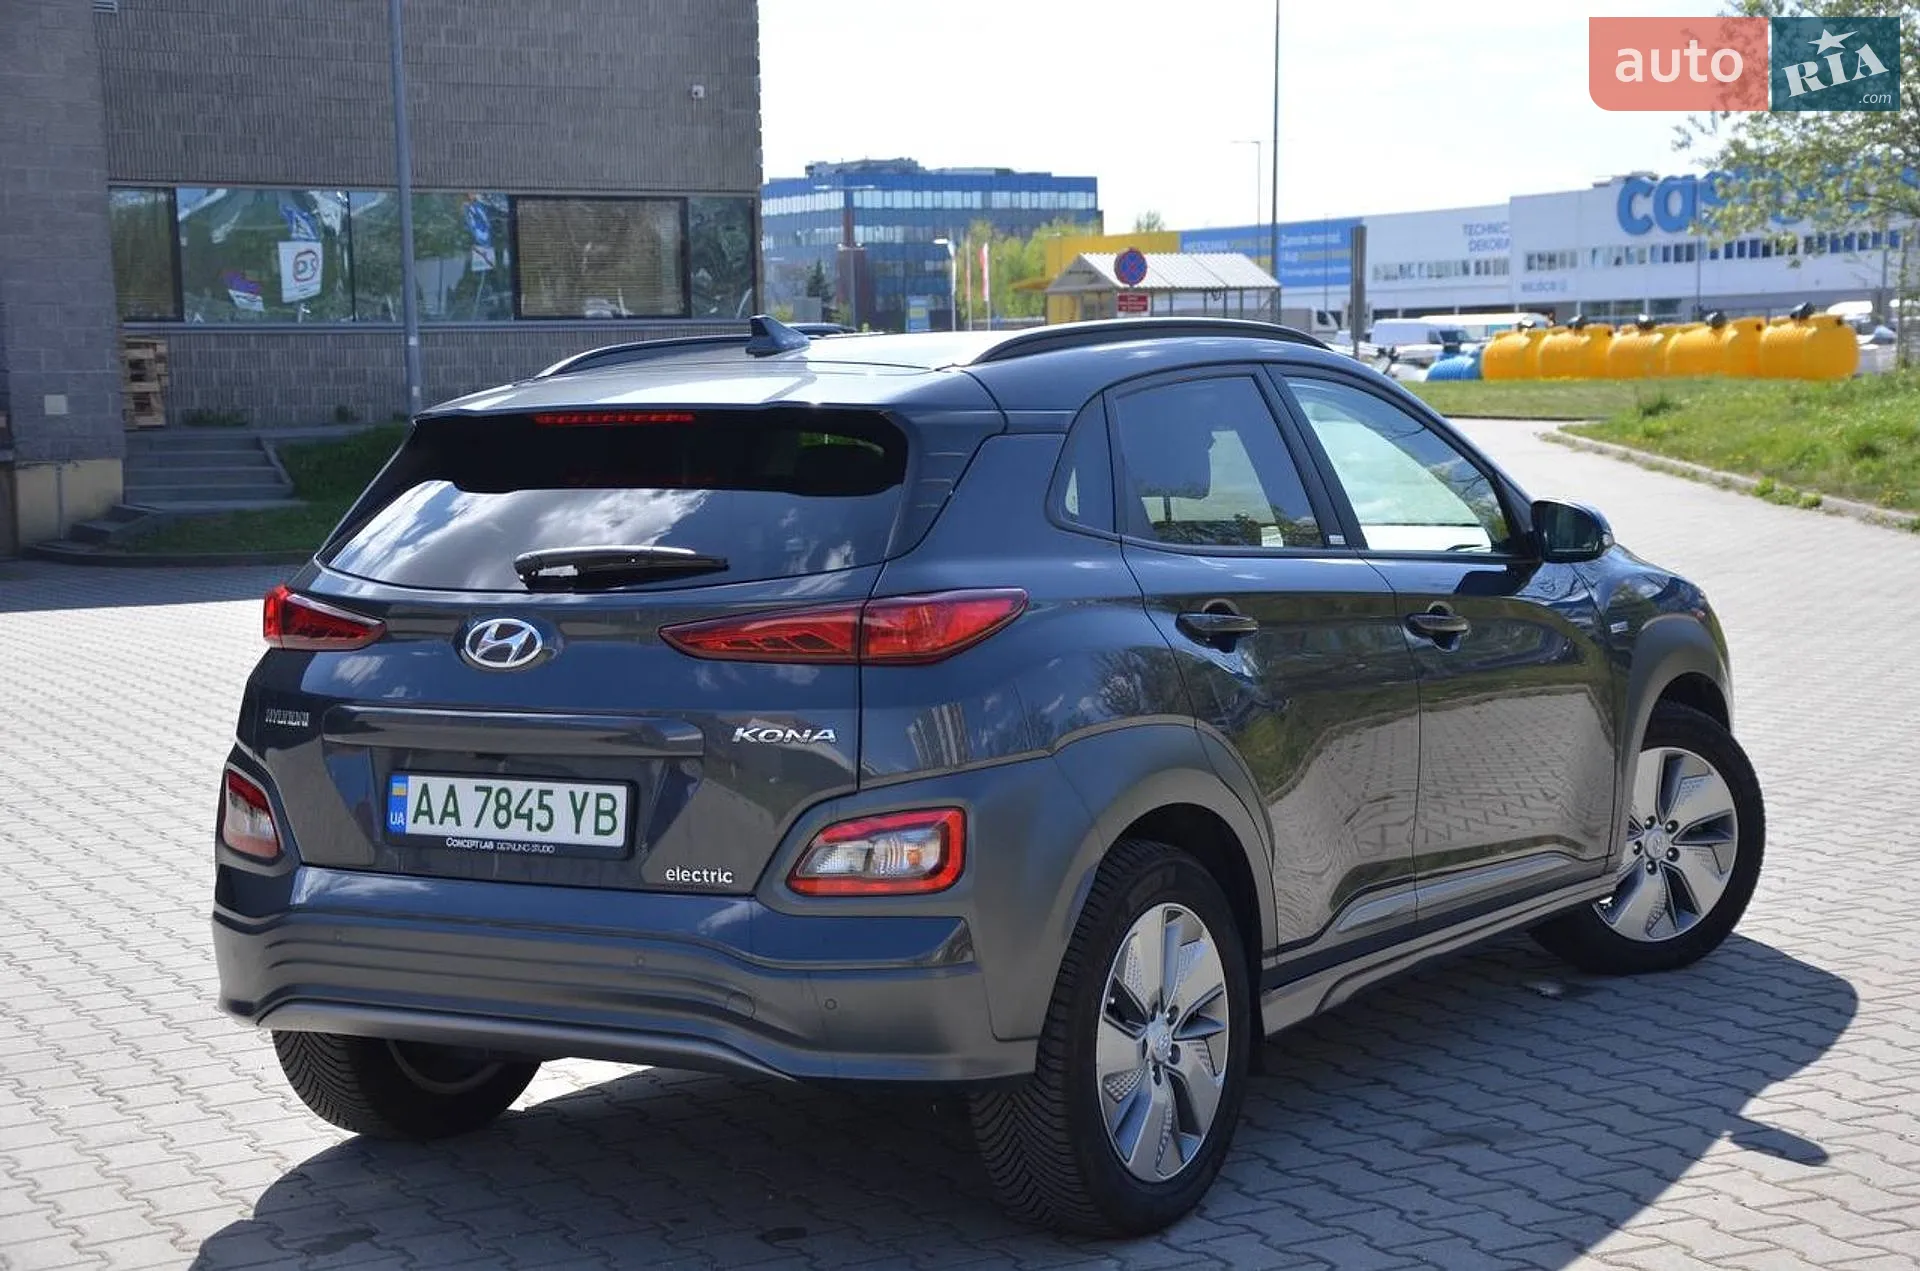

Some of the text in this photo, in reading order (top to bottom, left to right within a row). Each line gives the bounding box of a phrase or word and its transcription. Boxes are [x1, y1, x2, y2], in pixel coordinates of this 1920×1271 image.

[732, 727, 837, 743] KONA
[412, 783, 619, 836] AA 7845 YB
[390, 812, 405, 826] UA
[665, 866, 733, 884] electric
